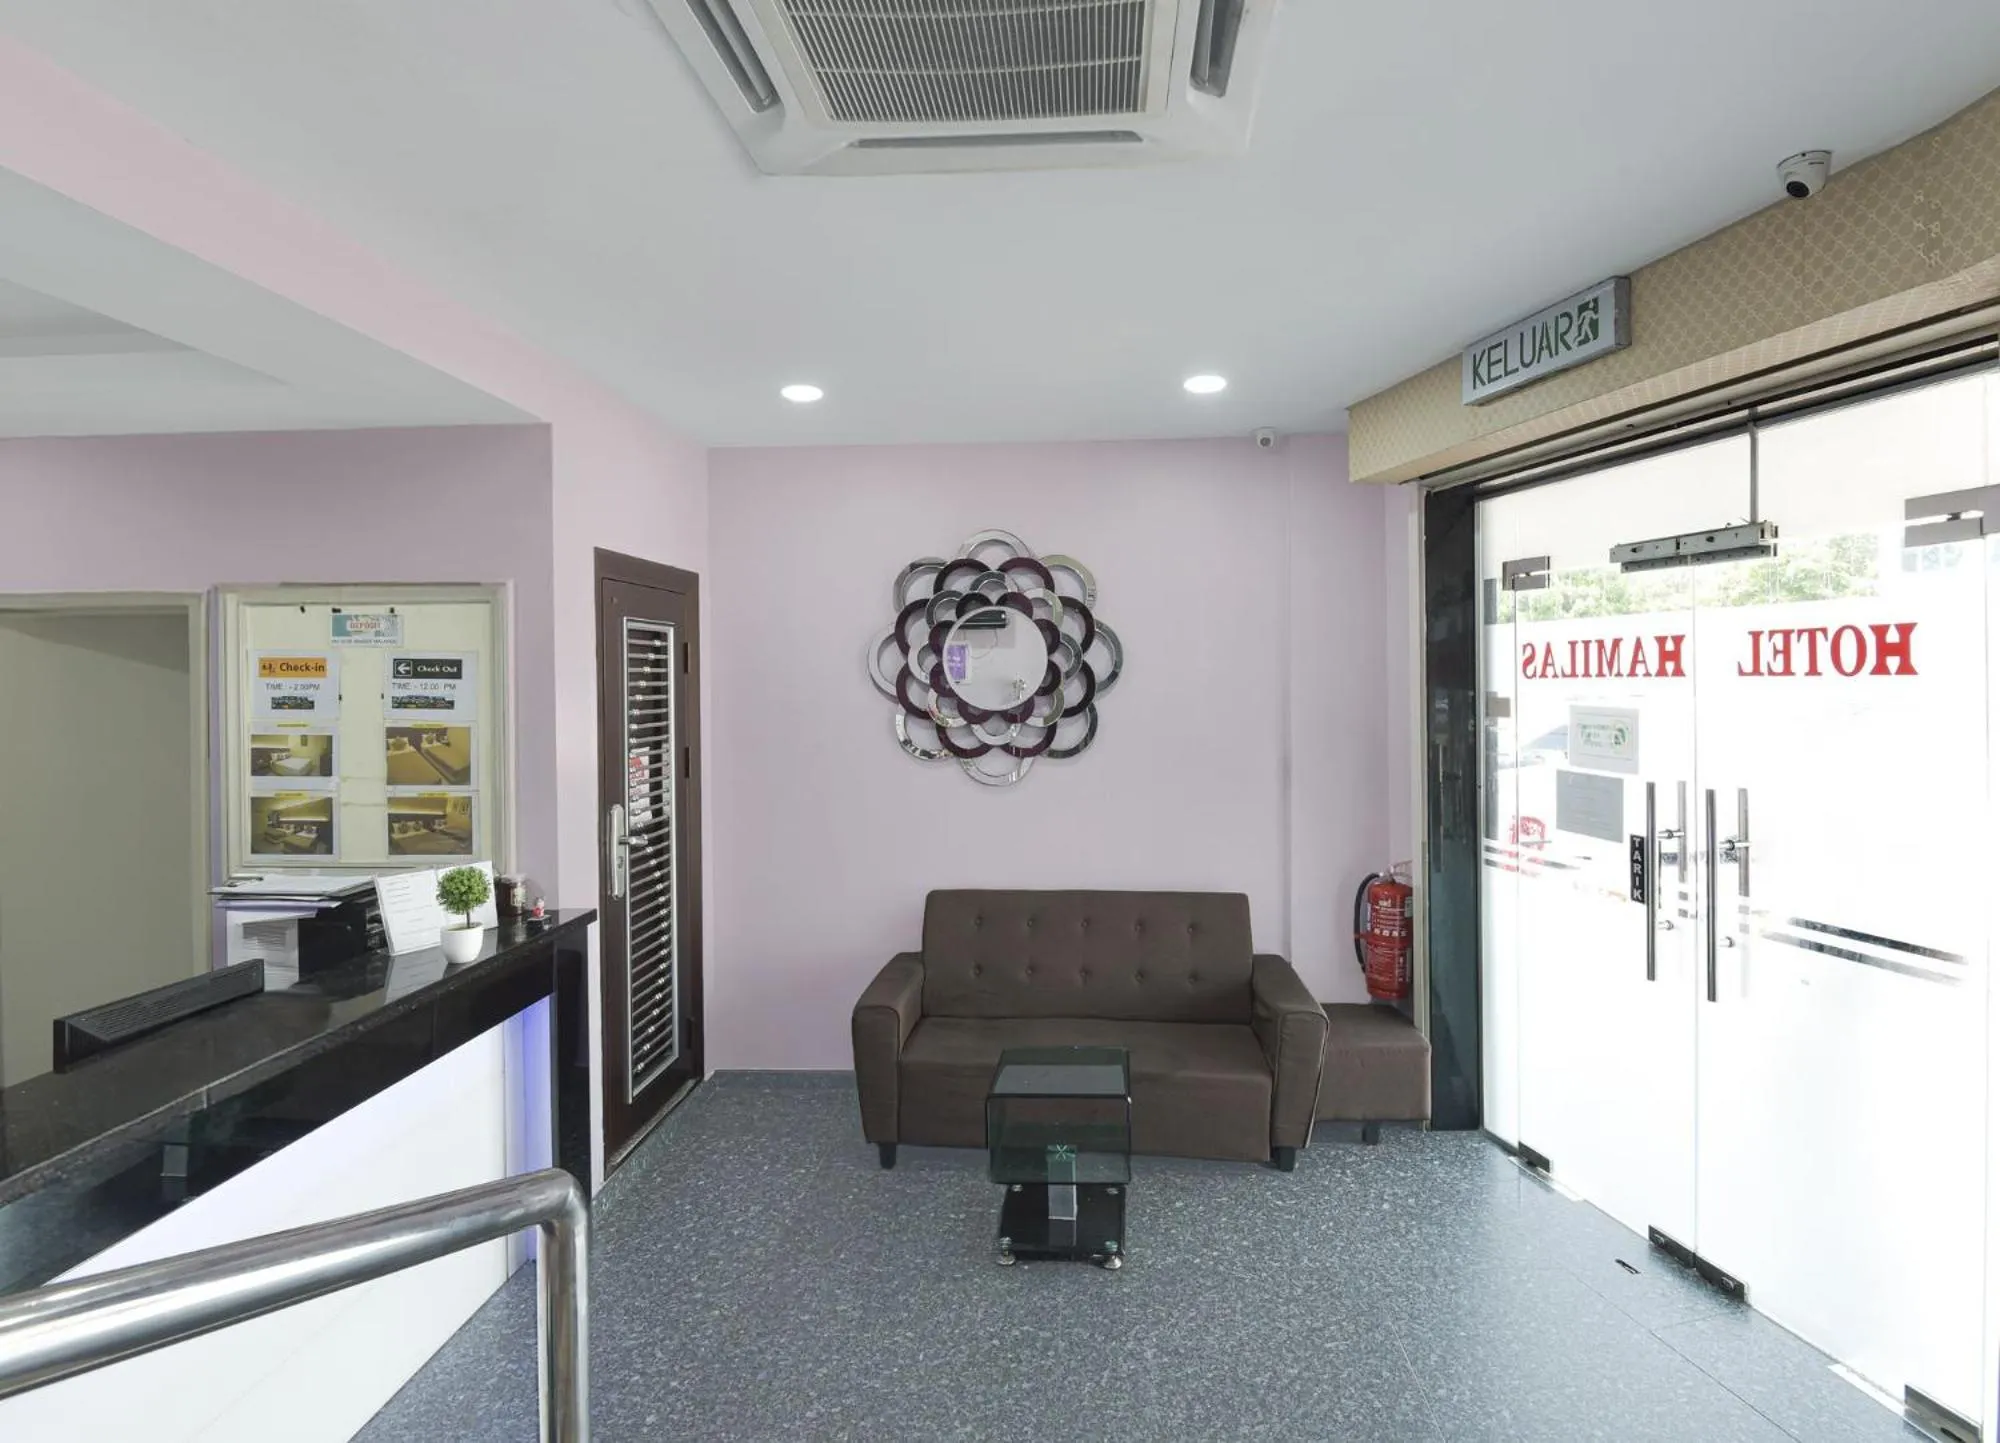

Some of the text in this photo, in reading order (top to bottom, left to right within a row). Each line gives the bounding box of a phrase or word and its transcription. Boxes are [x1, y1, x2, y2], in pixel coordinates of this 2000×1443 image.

[1472, 311, 1573, 390] KELUAR
[279, 662, 325, 672] Check-in
[417, 664, 440, 673] Check
[1632, 837, 1642, 900] TARIK
